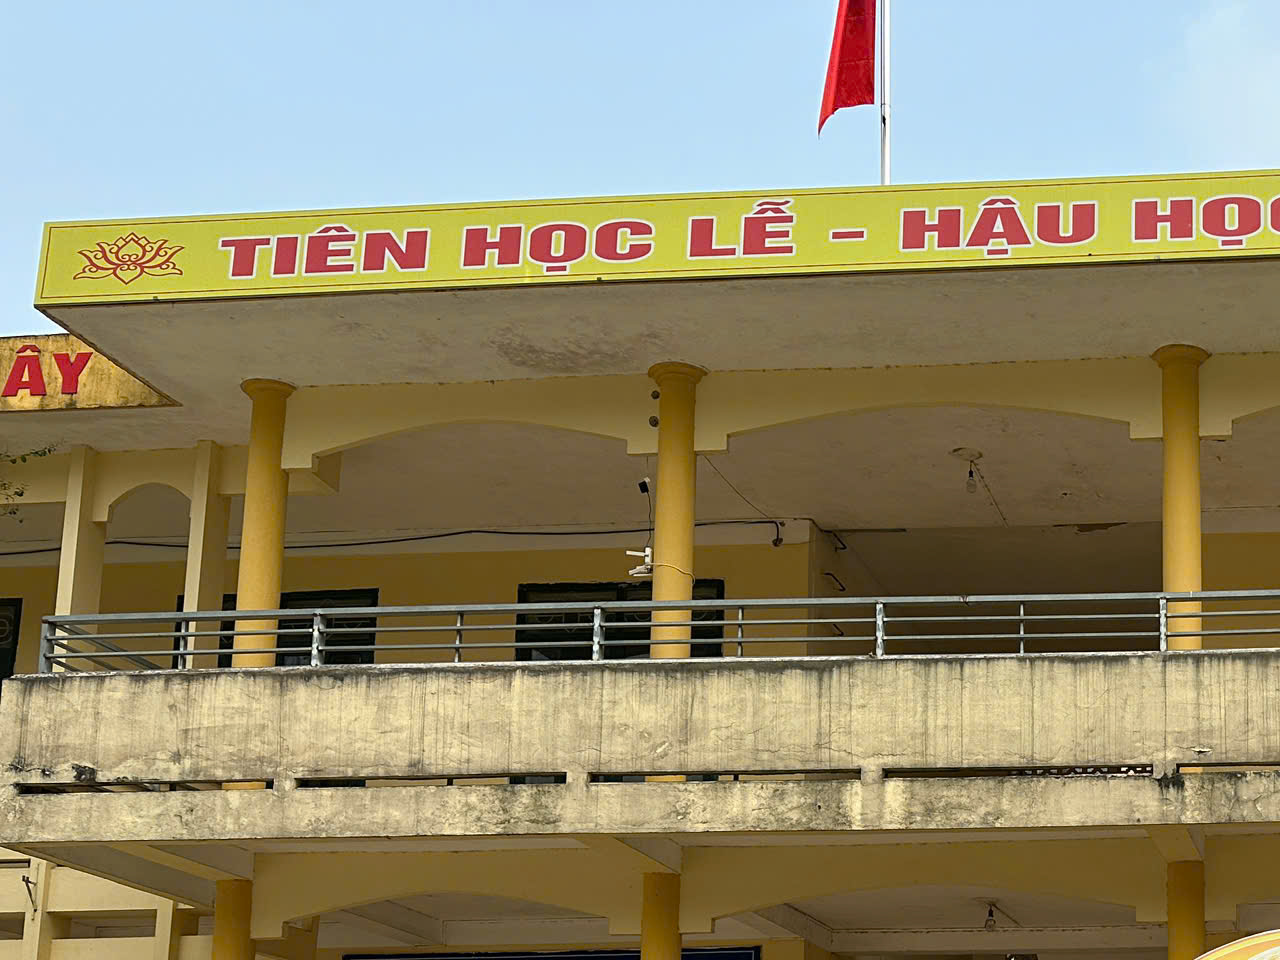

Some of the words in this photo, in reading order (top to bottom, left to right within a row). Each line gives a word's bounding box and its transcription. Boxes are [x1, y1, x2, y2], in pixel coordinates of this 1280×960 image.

[222, 227, 427, 276] TIÊN
[464, 222, 652, 272] HỌC
[690, 202, 792, 256] LỄ
[903, 200, 1094, 255] HẬU
